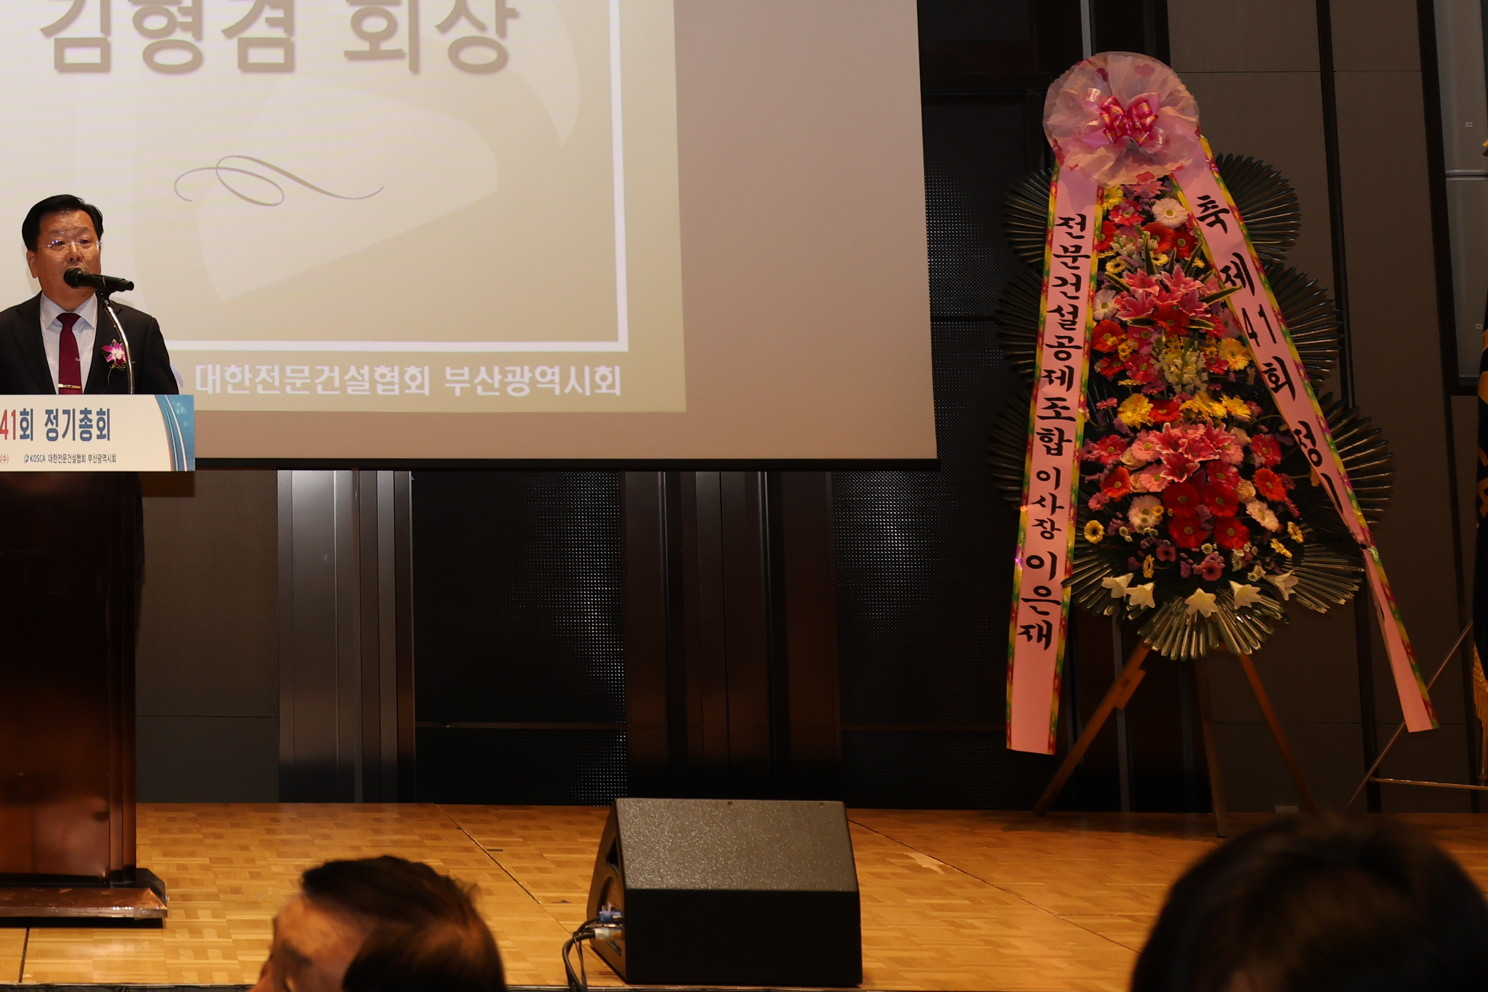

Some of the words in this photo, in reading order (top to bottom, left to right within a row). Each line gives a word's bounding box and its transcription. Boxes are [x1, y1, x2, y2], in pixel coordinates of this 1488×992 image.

[1196, 194, 1230, 234] 축
[1036, 213, 1092, 457] 전문건설공제조합
[194, 363, 431, 396] 대한전문건설협회
[443, 364, 622, 397] 부산광역시회
[45, 408, 110, 442] 정기총회
[1030, 467, 1065, 540] 이사장
[1017, 551, 1062, 651] 이은재
